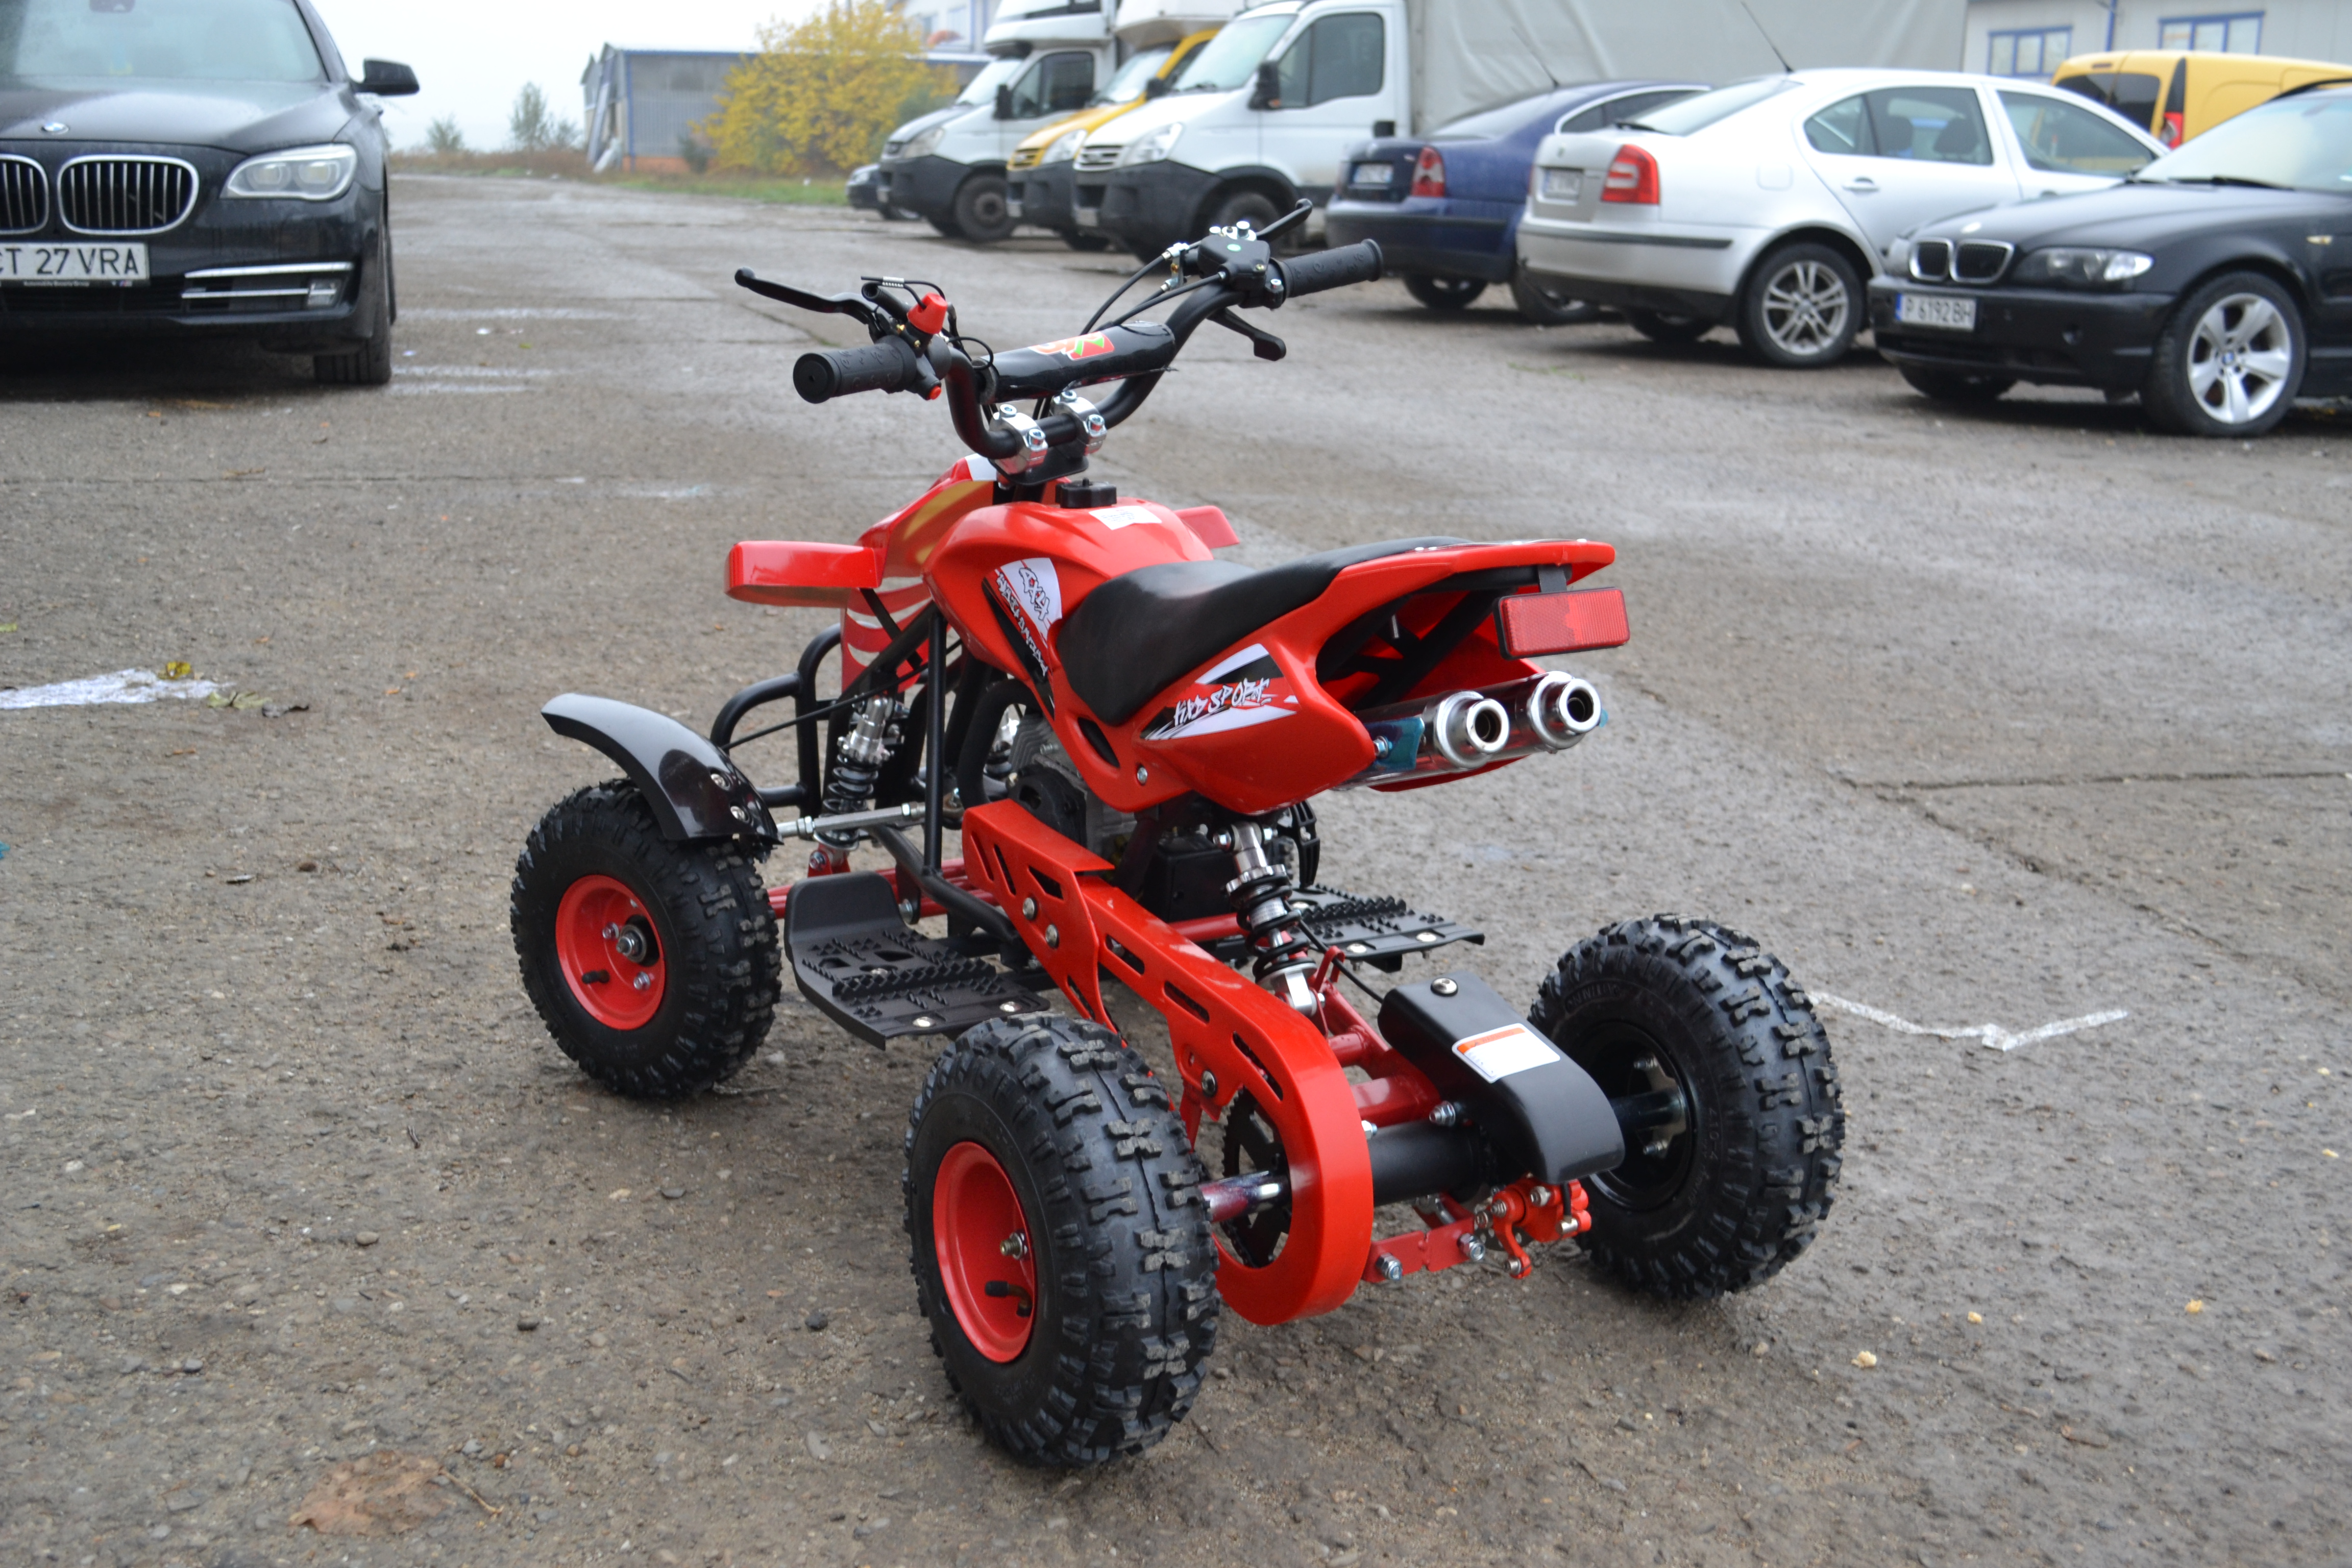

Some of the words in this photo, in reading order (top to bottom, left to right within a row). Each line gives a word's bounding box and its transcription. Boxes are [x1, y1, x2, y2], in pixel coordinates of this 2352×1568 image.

[0, 248, 21, 275] T
[35, 248, 70, 275] 27
[77, 248, 139, 275] VRA
[1173, 694, 1209, 727] KXD
[1208, 677, 1270, 715] SPORT
